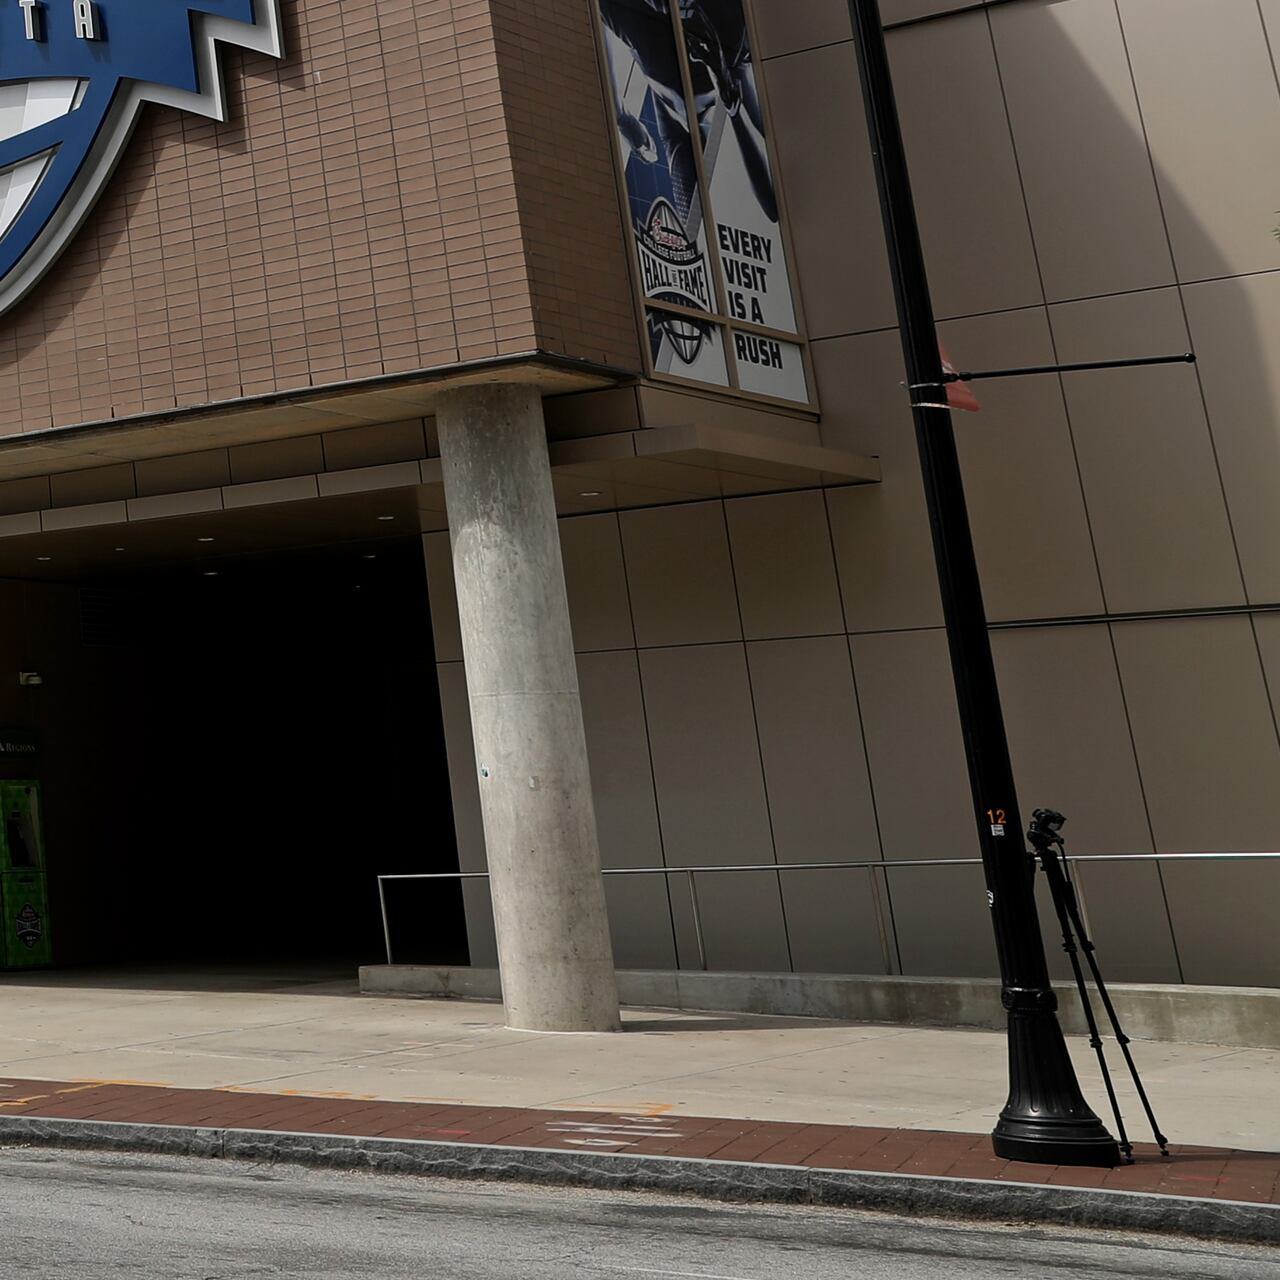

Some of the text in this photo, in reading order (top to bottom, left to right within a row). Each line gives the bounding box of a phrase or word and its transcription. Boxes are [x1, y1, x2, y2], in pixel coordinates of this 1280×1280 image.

[644, 236, 669, 255] COLLEGE
[717, 223, 772, 264] EVERY
[642, 251, 672, 292] HALL
[678, 265, 707, 306] FAME
[721, 257, 767, 293] VISIT
[728, 291, 747, 319] IS
[751, 297, 765, 324] A
[734, 333, 783, 370] RUSH
[6, 742, 35, 752] REGIONS
[987, 809, 1007, 824] 12
